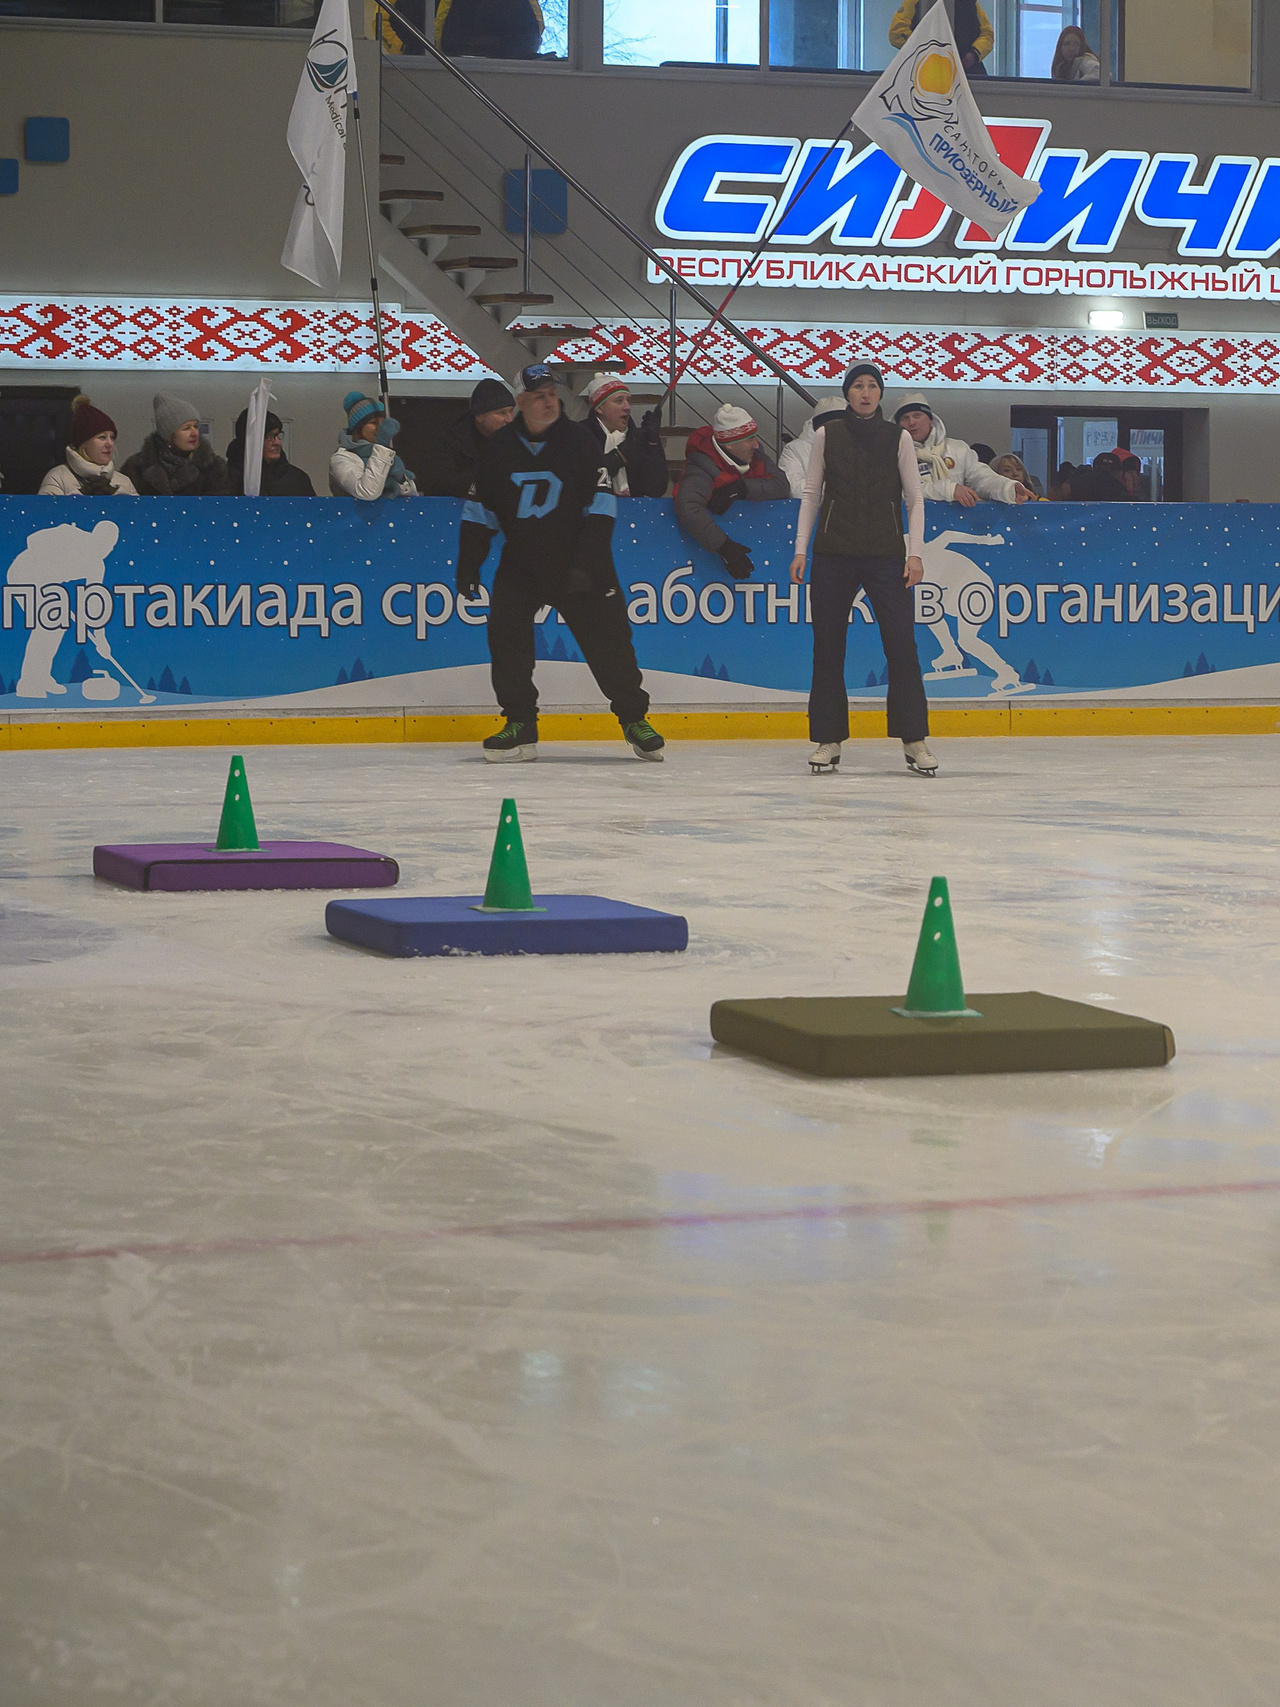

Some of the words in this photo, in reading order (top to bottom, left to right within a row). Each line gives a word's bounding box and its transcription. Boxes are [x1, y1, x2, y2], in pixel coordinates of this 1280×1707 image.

[928, 133, 1019, 214] ПРИОЗЁРНЫЙ
[655, 256, 998, 289] РЕСПУБЛИКАНСКИЙ
[1005, 265, 1261, 292] ГОРНОЛЫЖНЫЙ
[1147, 316, 1177, 326] ВЫХОД
[2, 582, 364, 642] партакиада
